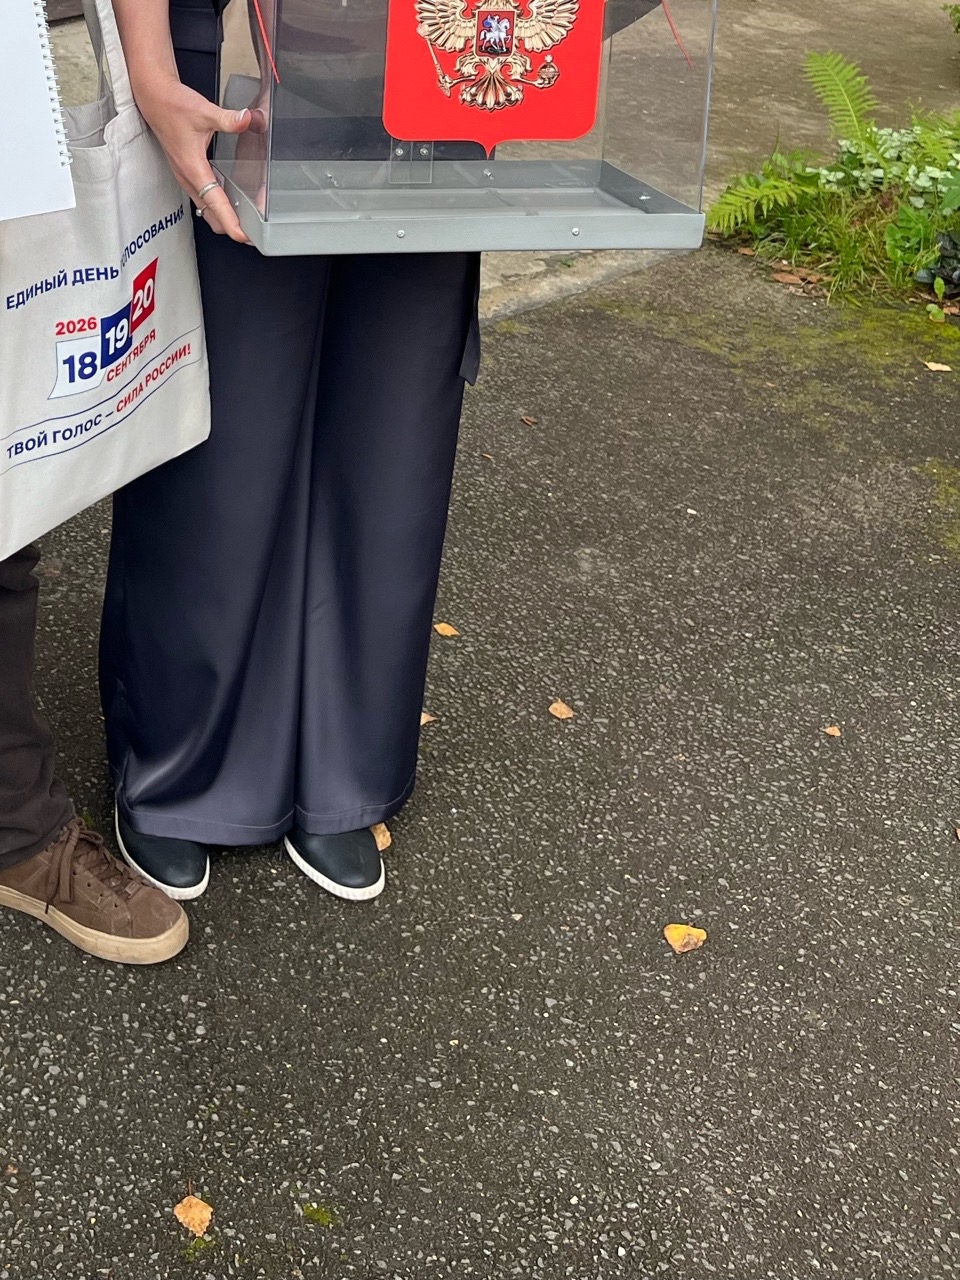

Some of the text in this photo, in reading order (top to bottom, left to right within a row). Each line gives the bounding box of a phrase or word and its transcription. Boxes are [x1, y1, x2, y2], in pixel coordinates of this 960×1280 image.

[6, 204, 185, 310] ЕДИНЫЙ ДЕНЬ ОЛОСОВАНИЯ
[55, 317, 98, 336] 2026
[63, 277, 155, 384] 18 19 20
[106, 328, 156, 382] СЕНТЯБРЯ
[6, 431, 48, 459] ТВОЙ
[52, 413, 103, 444] ГОЛОС
[116, 382, 144, 413] СИЛА
[145, 343, 191, 386] РОССИИ!
